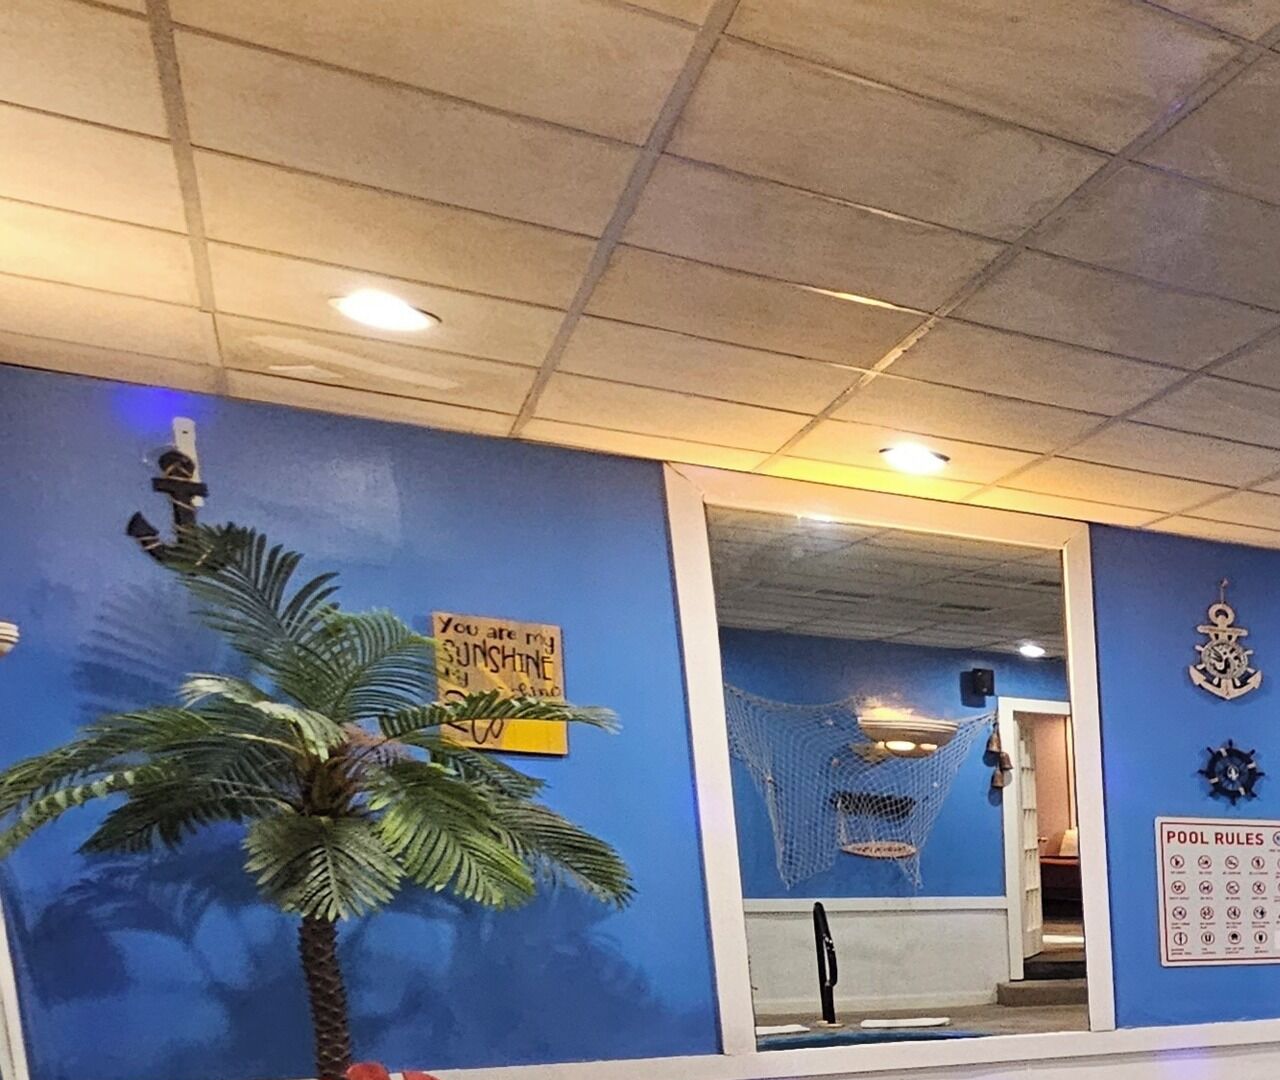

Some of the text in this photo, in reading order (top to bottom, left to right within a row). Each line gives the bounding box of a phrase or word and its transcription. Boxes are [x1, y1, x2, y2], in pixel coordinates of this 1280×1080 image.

[438, 615, 554, 655] You are my
[443, 638, 554, 681] SUNSHINE
[1166, 830, 1265, 846] POOL RULES
